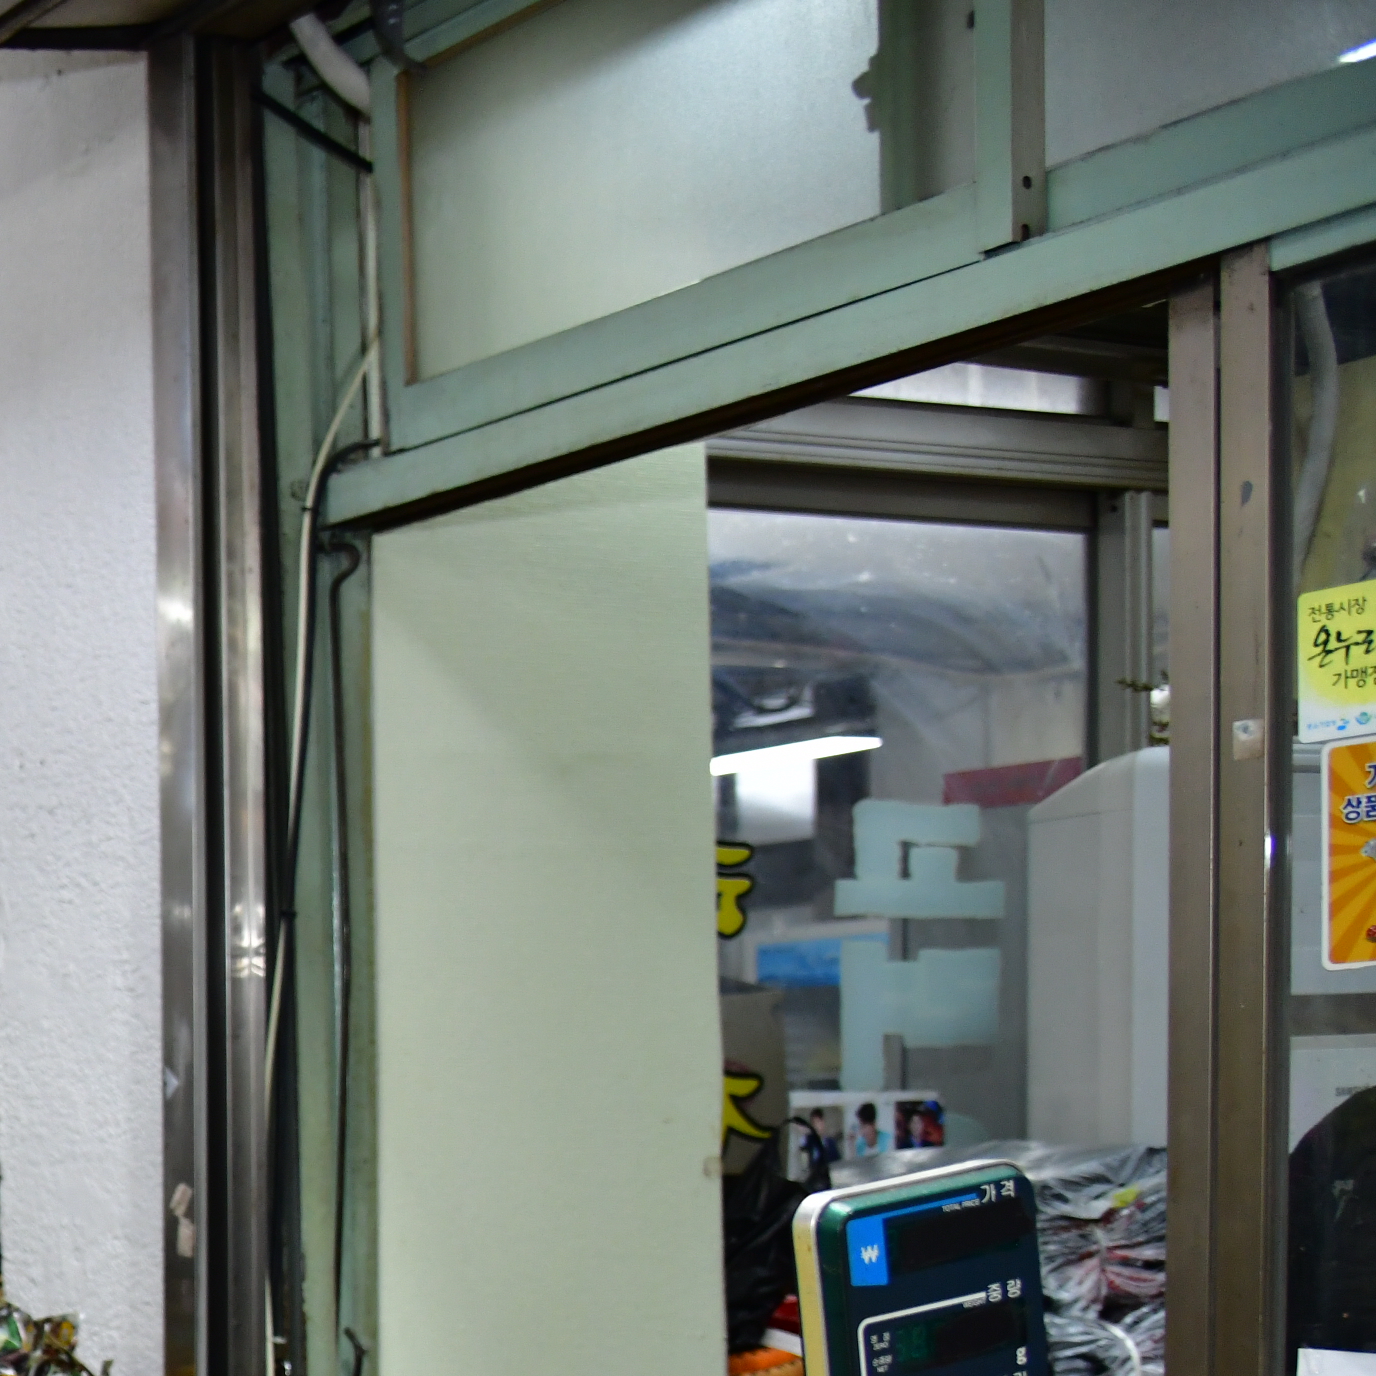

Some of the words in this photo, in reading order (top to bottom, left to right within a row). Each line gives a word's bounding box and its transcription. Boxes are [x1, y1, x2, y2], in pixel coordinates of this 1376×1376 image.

[1307, 596, 1367, 623] 전통시장
[980, 1179, 1016, 1204] 가격
[987, 1277, 1022, 1303] 중량
[1016, 1346, 1028, 1365] g
